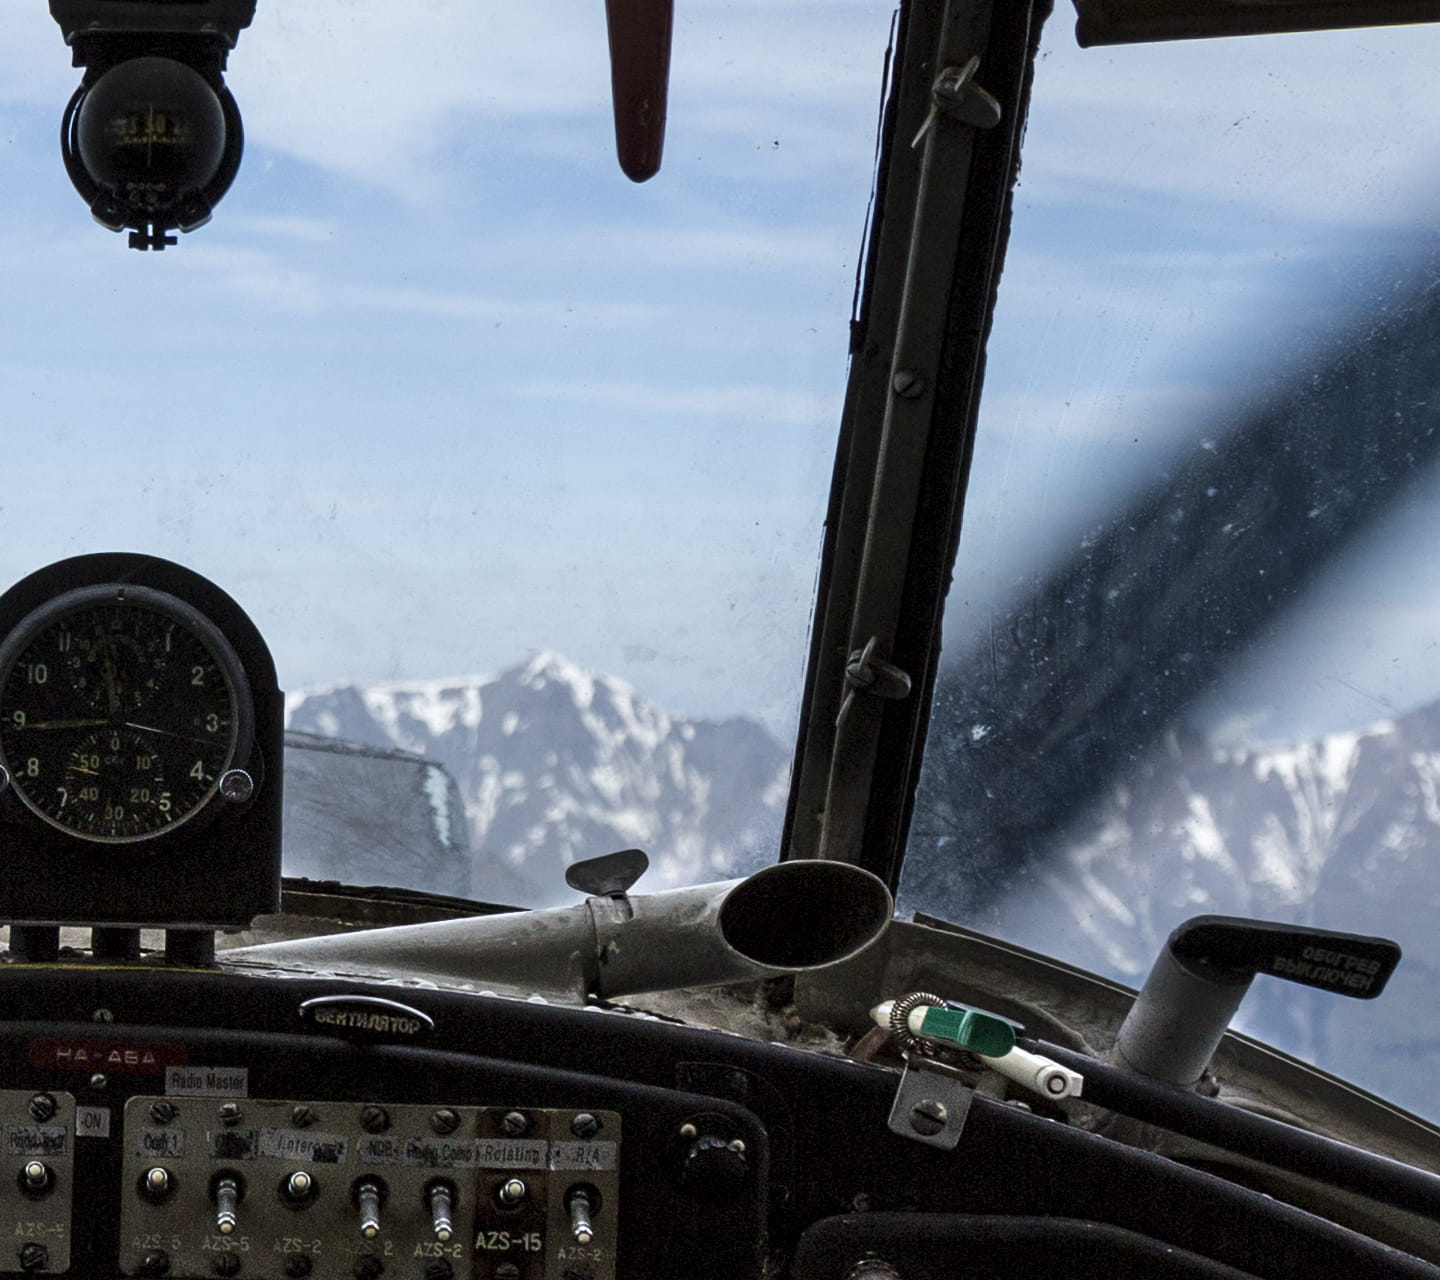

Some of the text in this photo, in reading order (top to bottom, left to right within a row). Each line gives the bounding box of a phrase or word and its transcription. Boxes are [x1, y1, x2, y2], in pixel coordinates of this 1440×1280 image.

[28, 664, 48, 683] 10
[191, 665, 204, 686] 2
[205, 713, 219, 732] 3
[27, 756, 40, 777] 8
[80, 755, 100, 768] 50
[189, 760, 204, 780] 4
[79, 787, 99, 801] 40
[130, 787, 150, 802] 20
[158, 792, 172, 811] 5
[56, 1048, 156, 1065] HA-ABA
[172, 1072, 244, 1090] Radio Master
[201, 1235, 250, 1252] AZS-5
[475, 1232, 542, 1252] AZS-15
